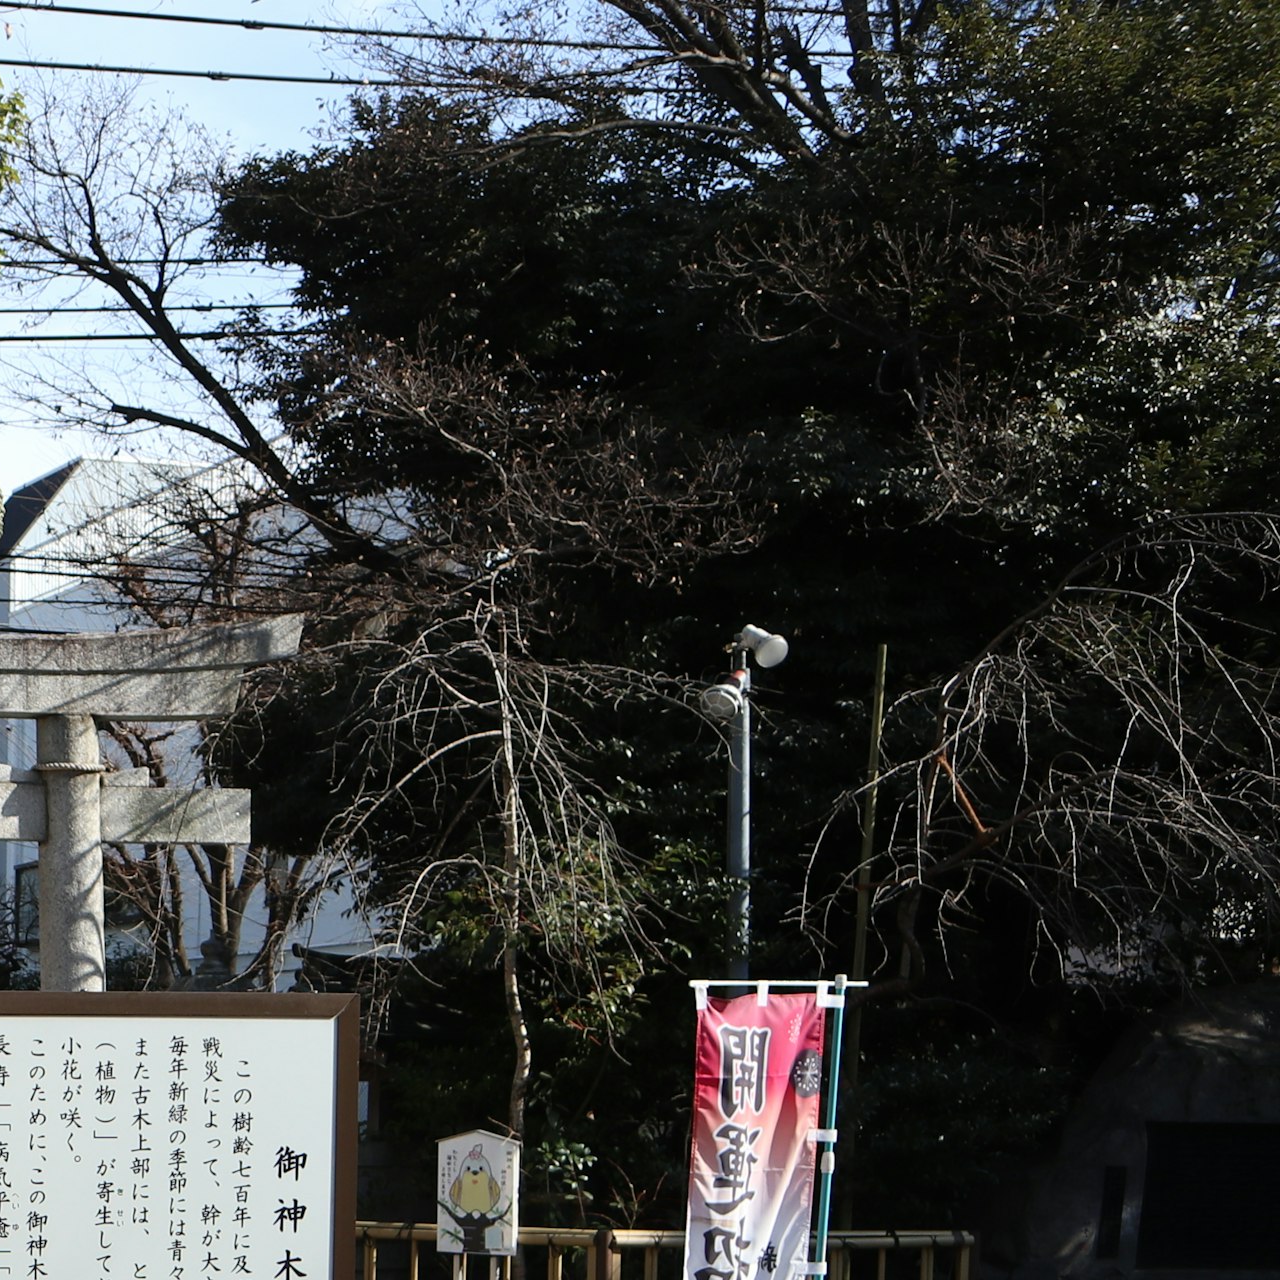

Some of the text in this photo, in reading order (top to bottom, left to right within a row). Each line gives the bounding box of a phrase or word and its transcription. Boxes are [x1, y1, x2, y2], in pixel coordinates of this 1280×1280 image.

[59, 1036, 83, 1165] 小花が咲く。
